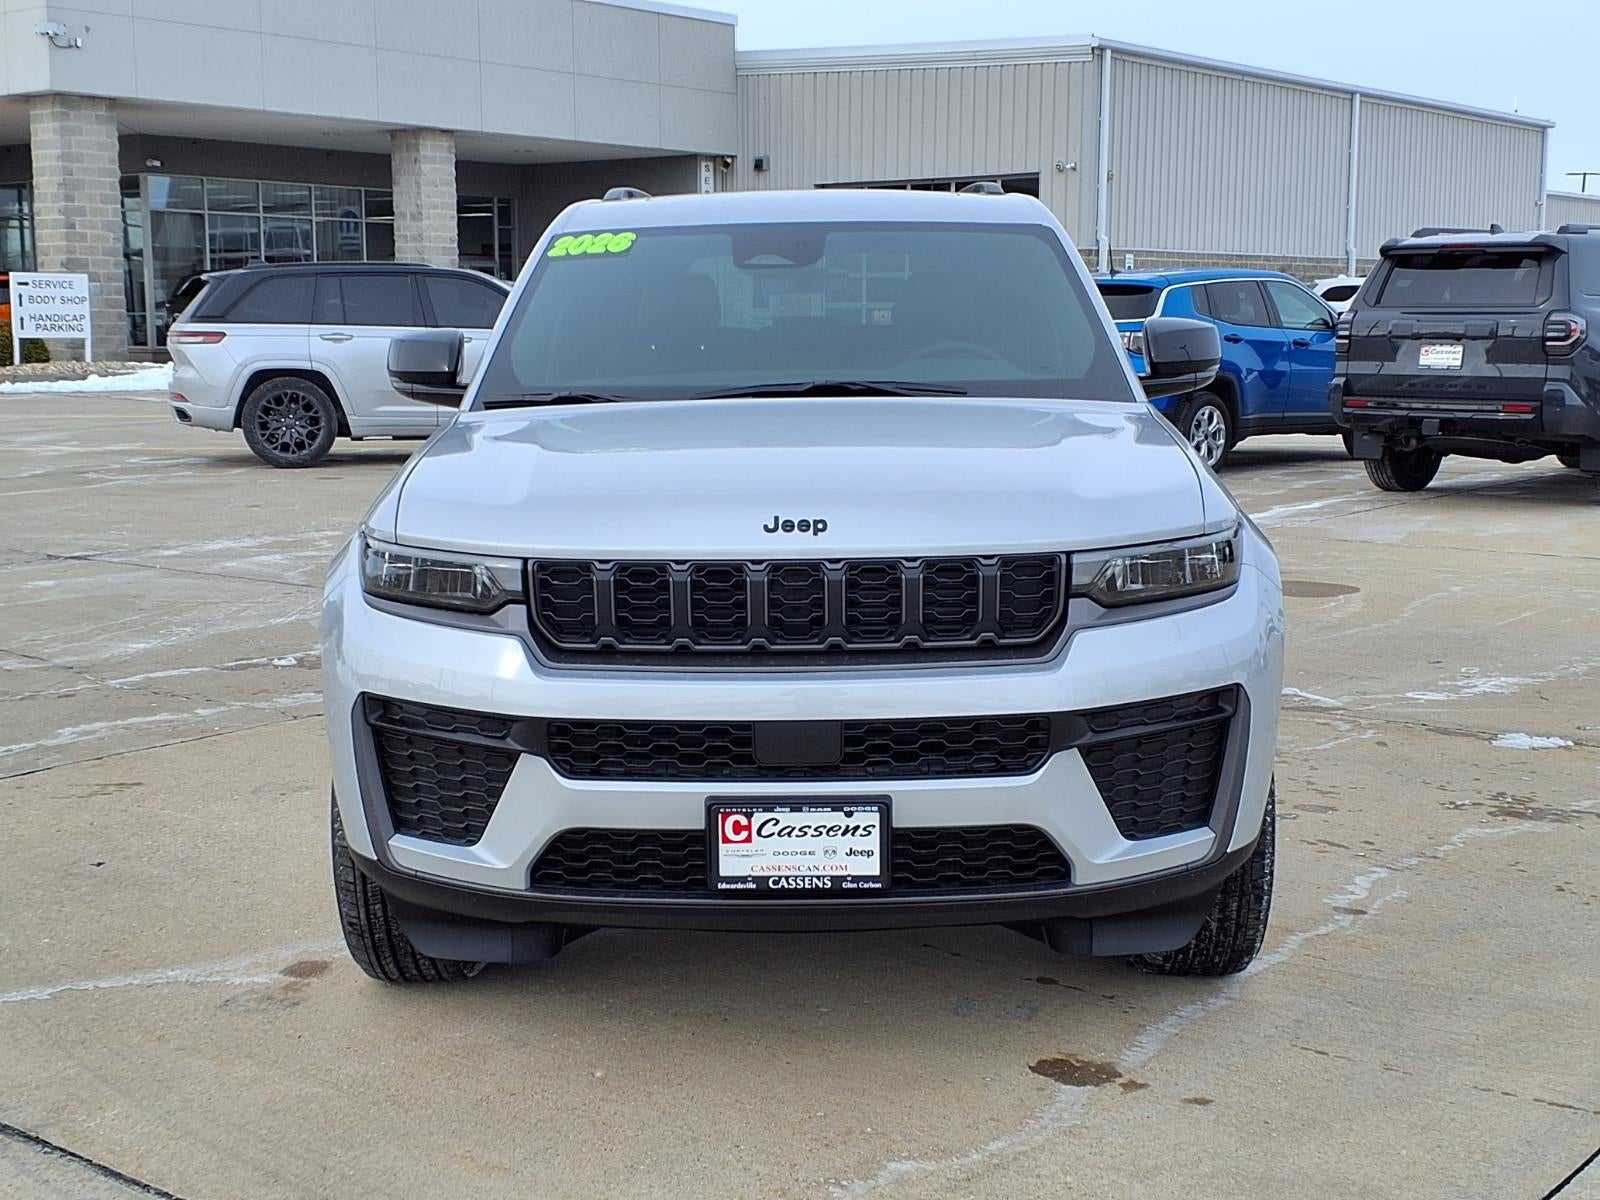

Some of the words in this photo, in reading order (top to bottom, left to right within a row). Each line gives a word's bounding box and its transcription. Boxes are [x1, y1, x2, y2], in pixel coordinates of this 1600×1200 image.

[547, 231, 637, 257] 2026
[31, 279, 75, 290] SERVICE
[28, 295, 57, 305] BODY
[60, 295, 88, 305] SHOP
[29, 313, 86, 323] HANDICAP
[35, 323, 84, 333] PARKING
[763, 515, 828, 536] Jeep
[724, 814, 749, 842] C
[756, 817, 876, 839] Cassens
[845, 847, 875, 859] Jeep
[751, 864, 848, 873] CASSENSCAN.COM
[717, 881, 757, 889] Edwardsville
[768, 876, 832, 889] CASSENS
[842, 881, 858, 889] Glen
[858, 881, 882, 889] Carbon
